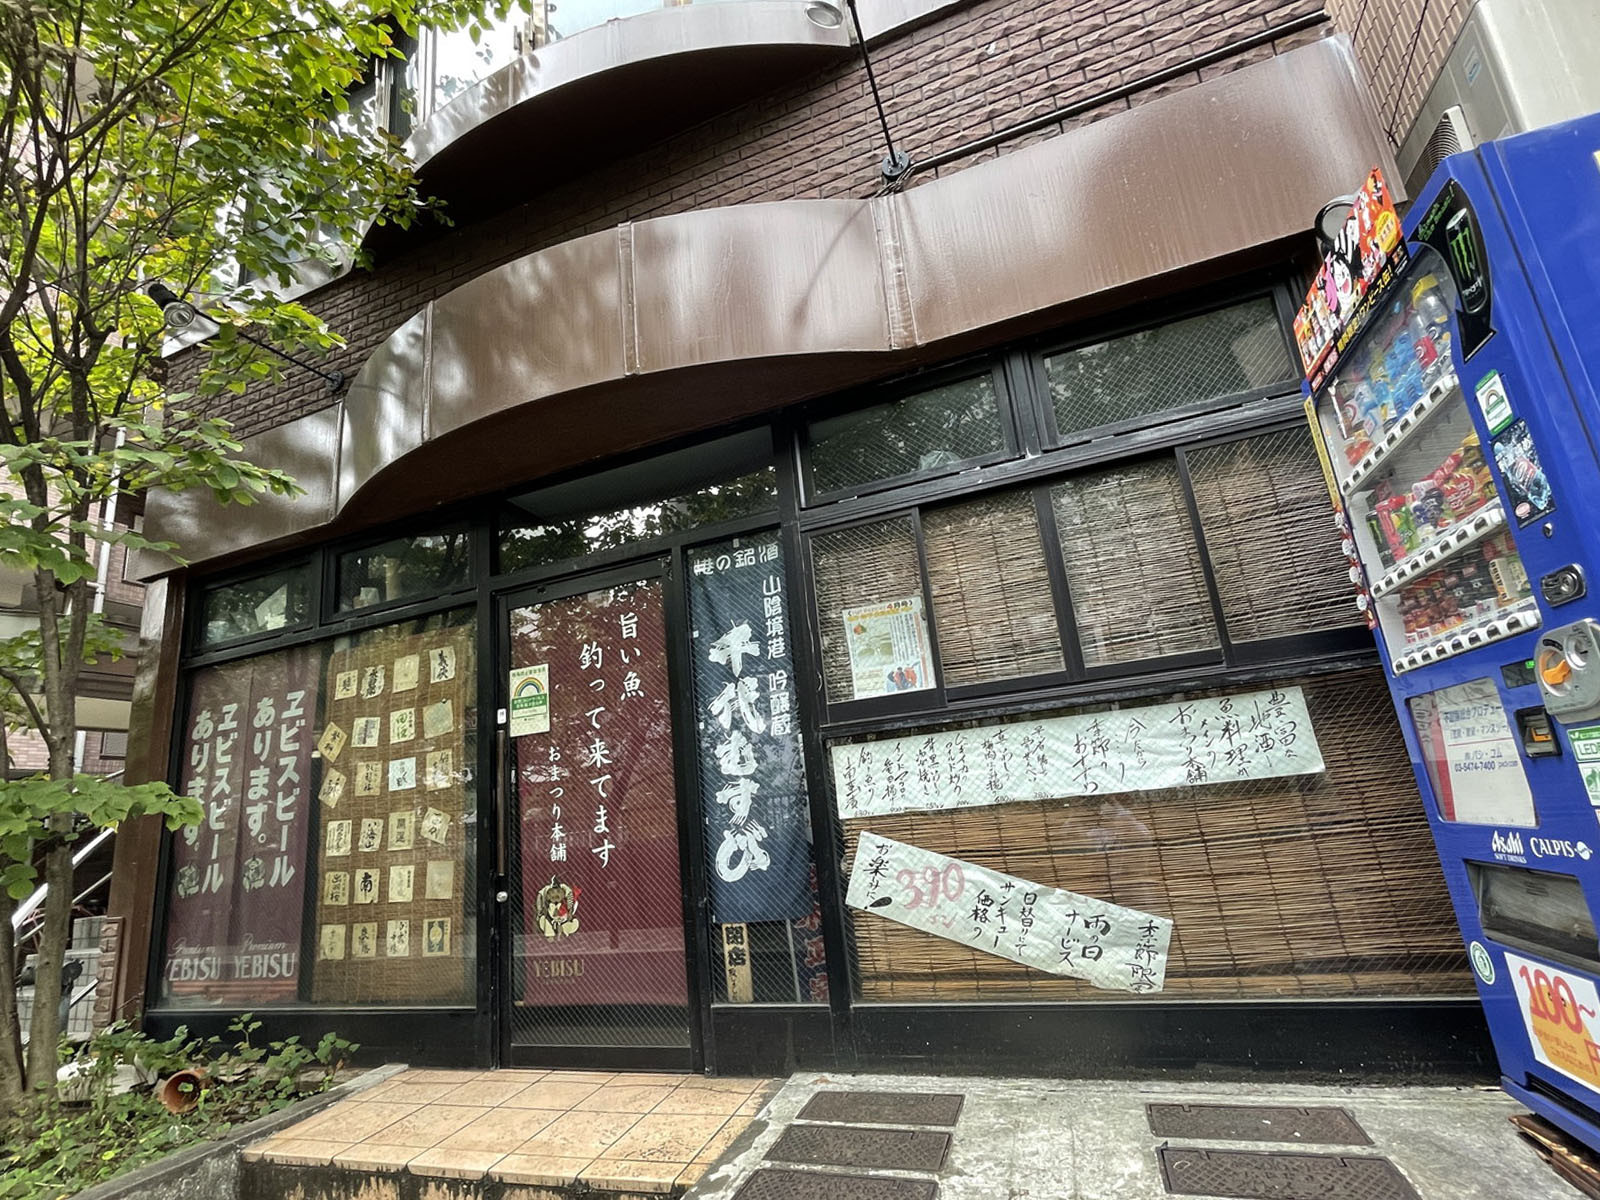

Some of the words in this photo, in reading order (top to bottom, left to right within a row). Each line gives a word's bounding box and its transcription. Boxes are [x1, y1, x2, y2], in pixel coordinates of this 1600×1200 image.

[693, 541, 779, 576] 港の銘酒
[762, 575, 786, 660] 山陰境港
[619, 612, 645, 700] 旨い魚
[246, 697, 276, 843] あります。
[578, 640, 616, 868] 釣って来てます
[708, 619, 771, 882] 千代むすび
[548, 745, 567, 862] おまつり本舗
[1492, 830, 1524, 855] Asahi
[1530, 837, 1575, 857] CALPIS
[896, 863, 966, 910] 390
[967, 888, 995, 940] 価格の
[994, 881, 1016, 949] サンキュー
[234, 952, 296, 979] YEBISU
[1081, 914, 1111, 962] 雨の日
[532, 959, 585, 978] YEBISU
